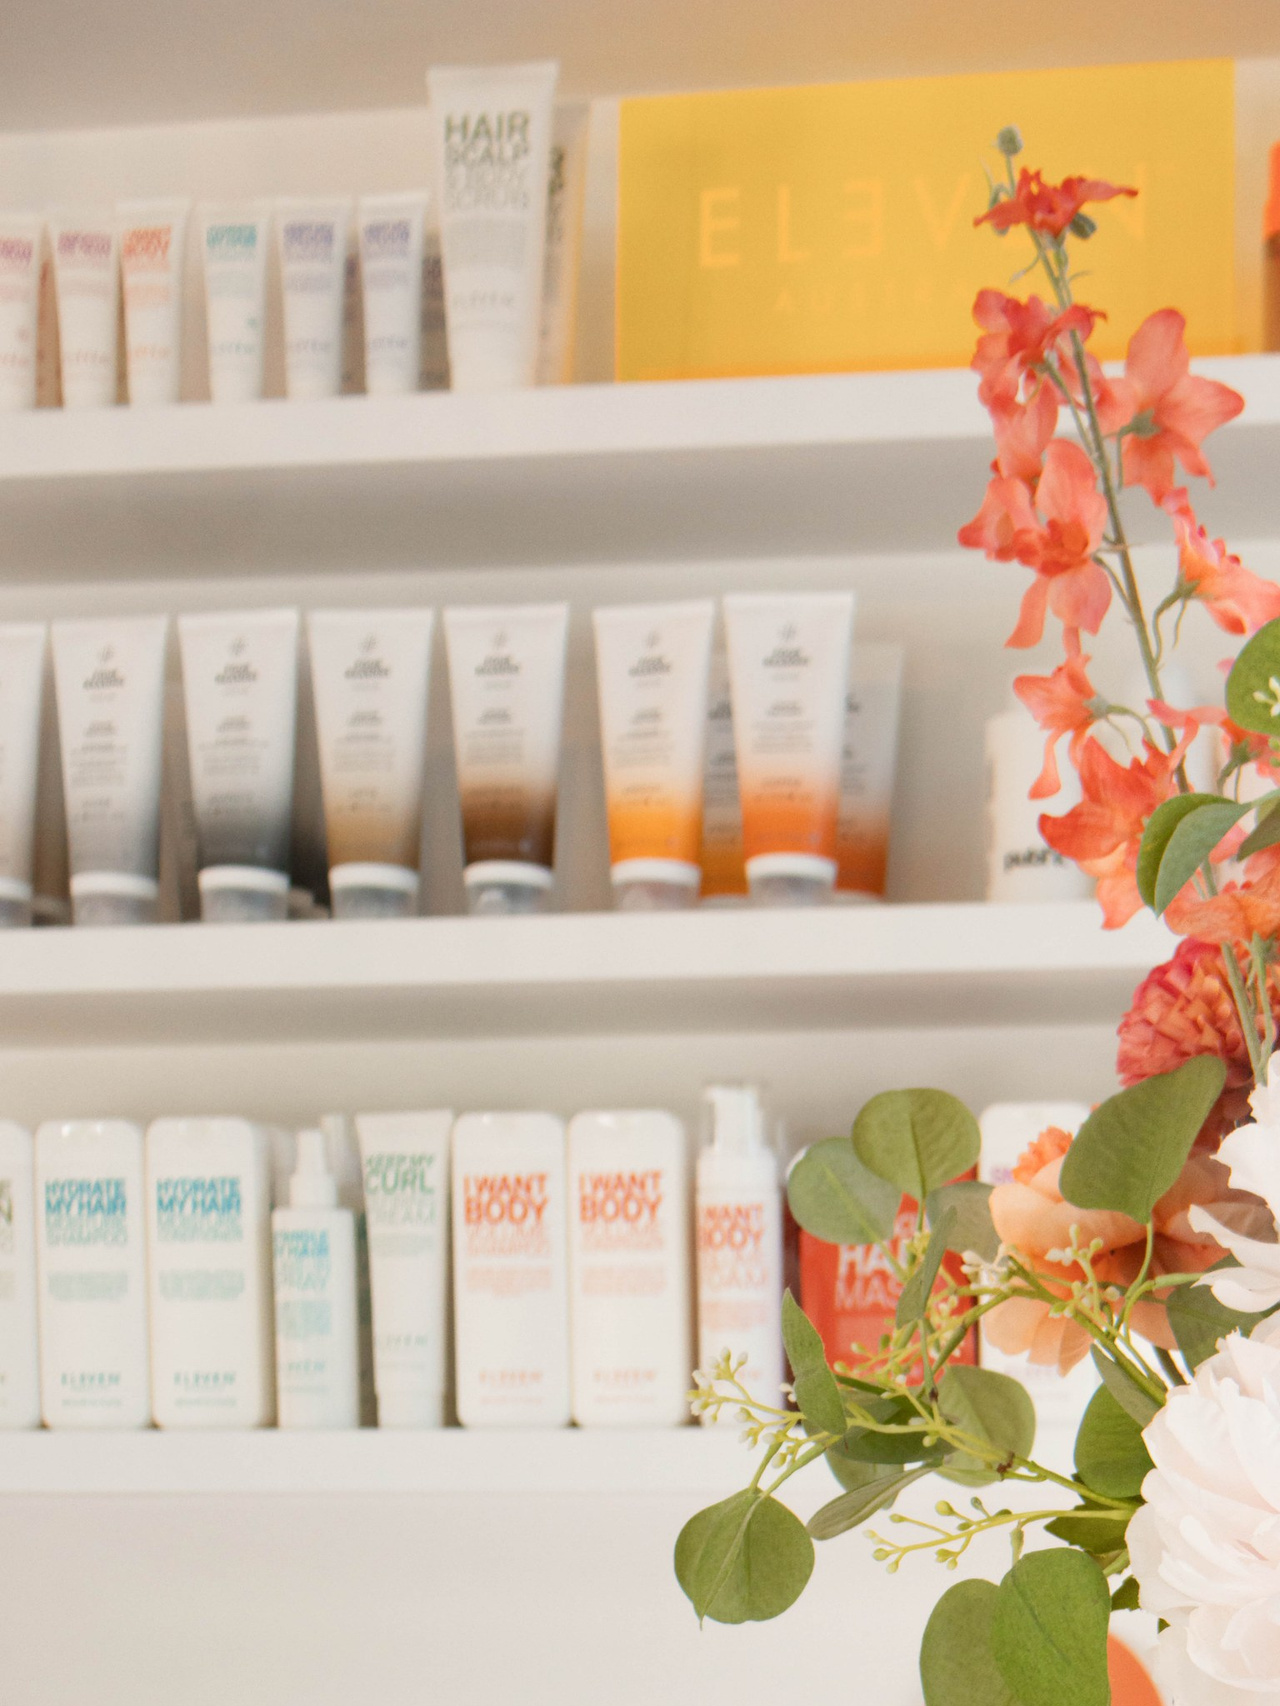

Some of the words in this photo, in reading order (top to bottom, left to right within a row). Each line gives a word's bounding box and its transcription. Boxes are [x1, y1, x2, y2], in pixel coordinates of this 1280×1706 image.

[444, 111, 530, 142] HAIR
[474, 1173, 547, 1194] WANT
[590, 1171, 662, 1192] WANT
[465, 1197, 548, 1224] BODY
[580, 1195, 662, 1223] BODY
